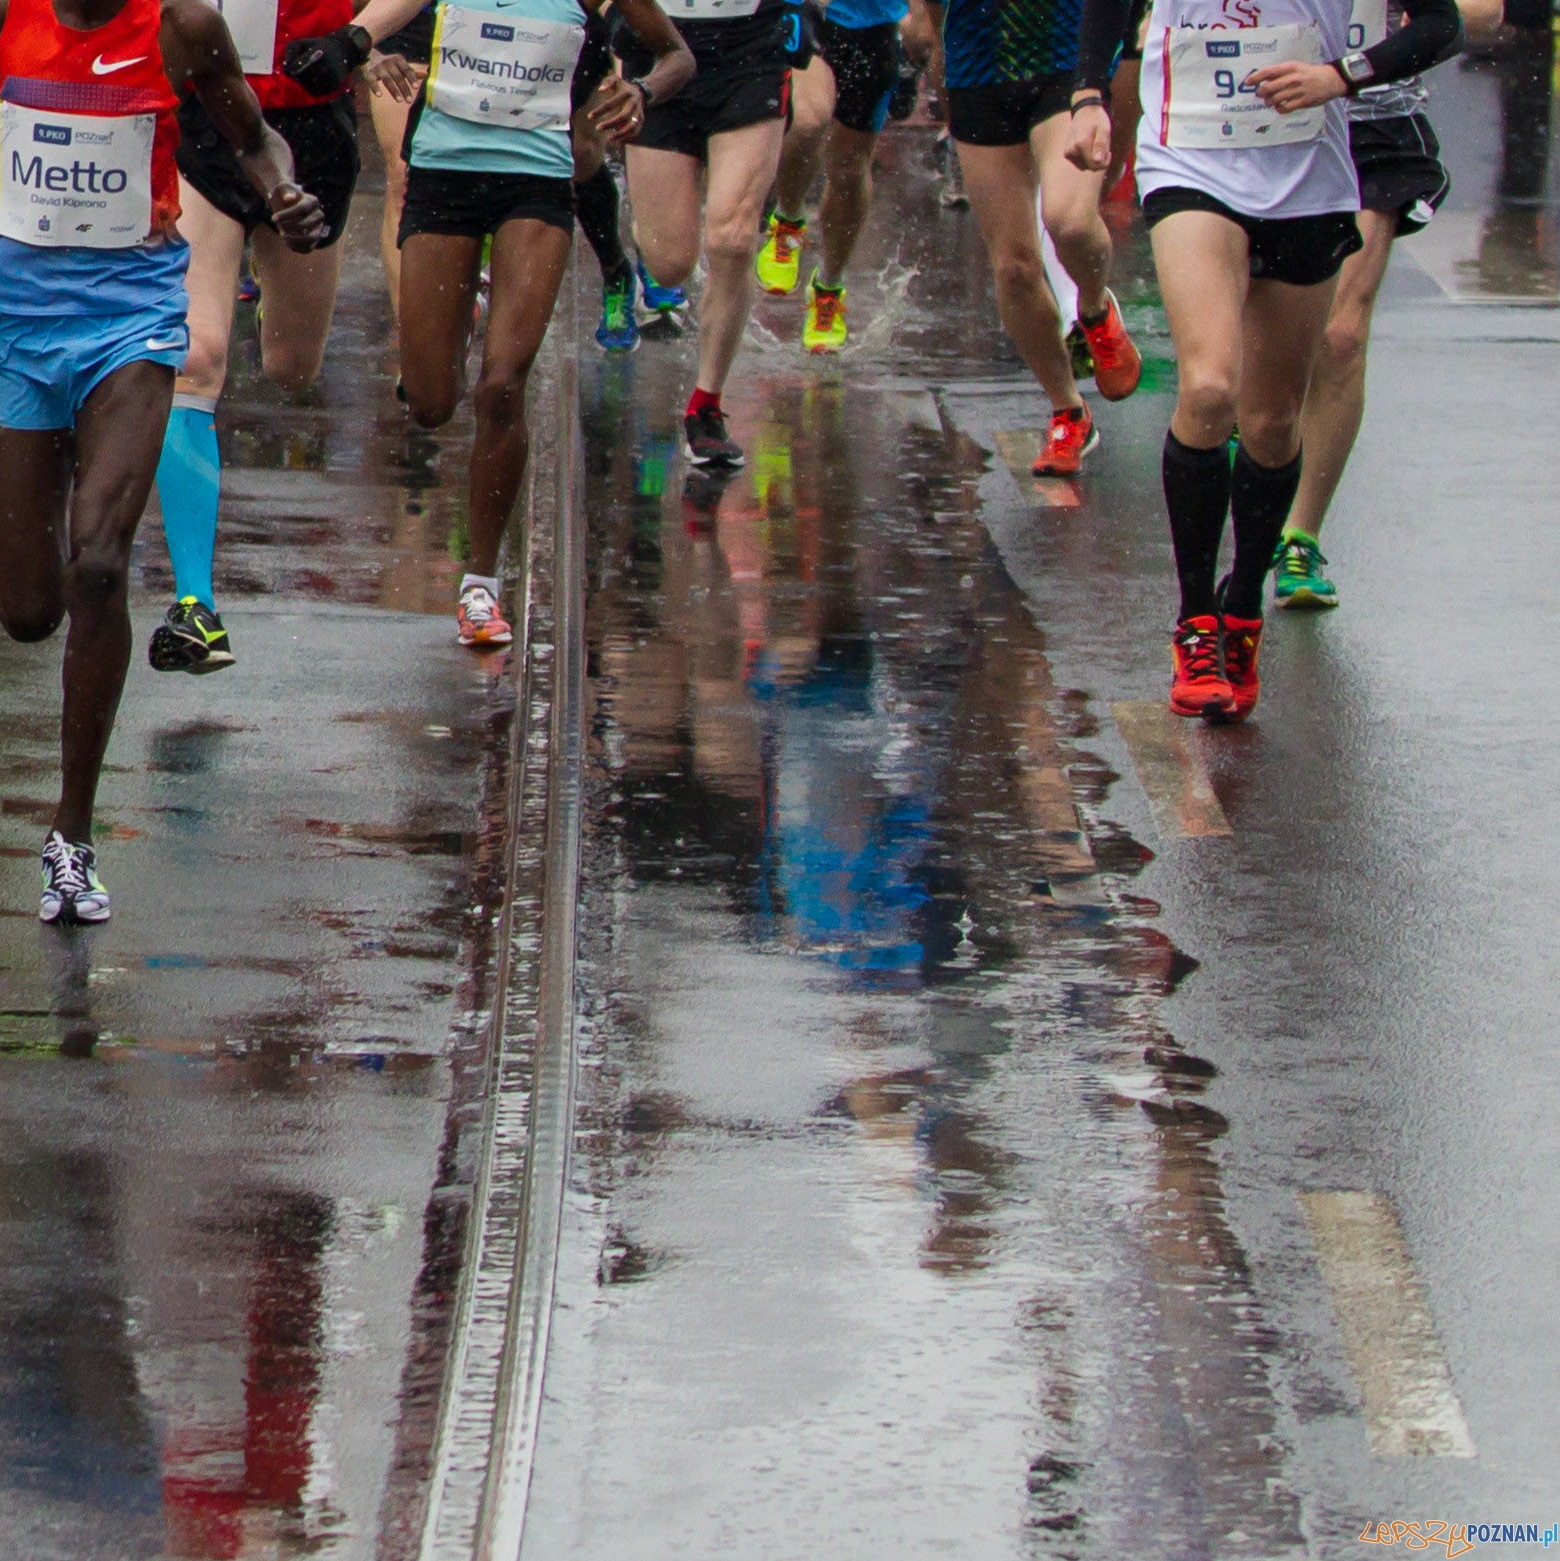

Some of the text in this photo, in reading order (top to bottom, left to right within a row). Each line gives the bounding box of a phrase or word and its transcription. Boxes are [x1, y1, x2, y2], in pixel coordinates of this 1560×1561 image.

[440, 46, 565, 83] Kwamboka
[38, 128, 66, 140] 9.PKO
[12, 149, 127, 194] Metto
[30, 193, 107, 209] David Kiprono
